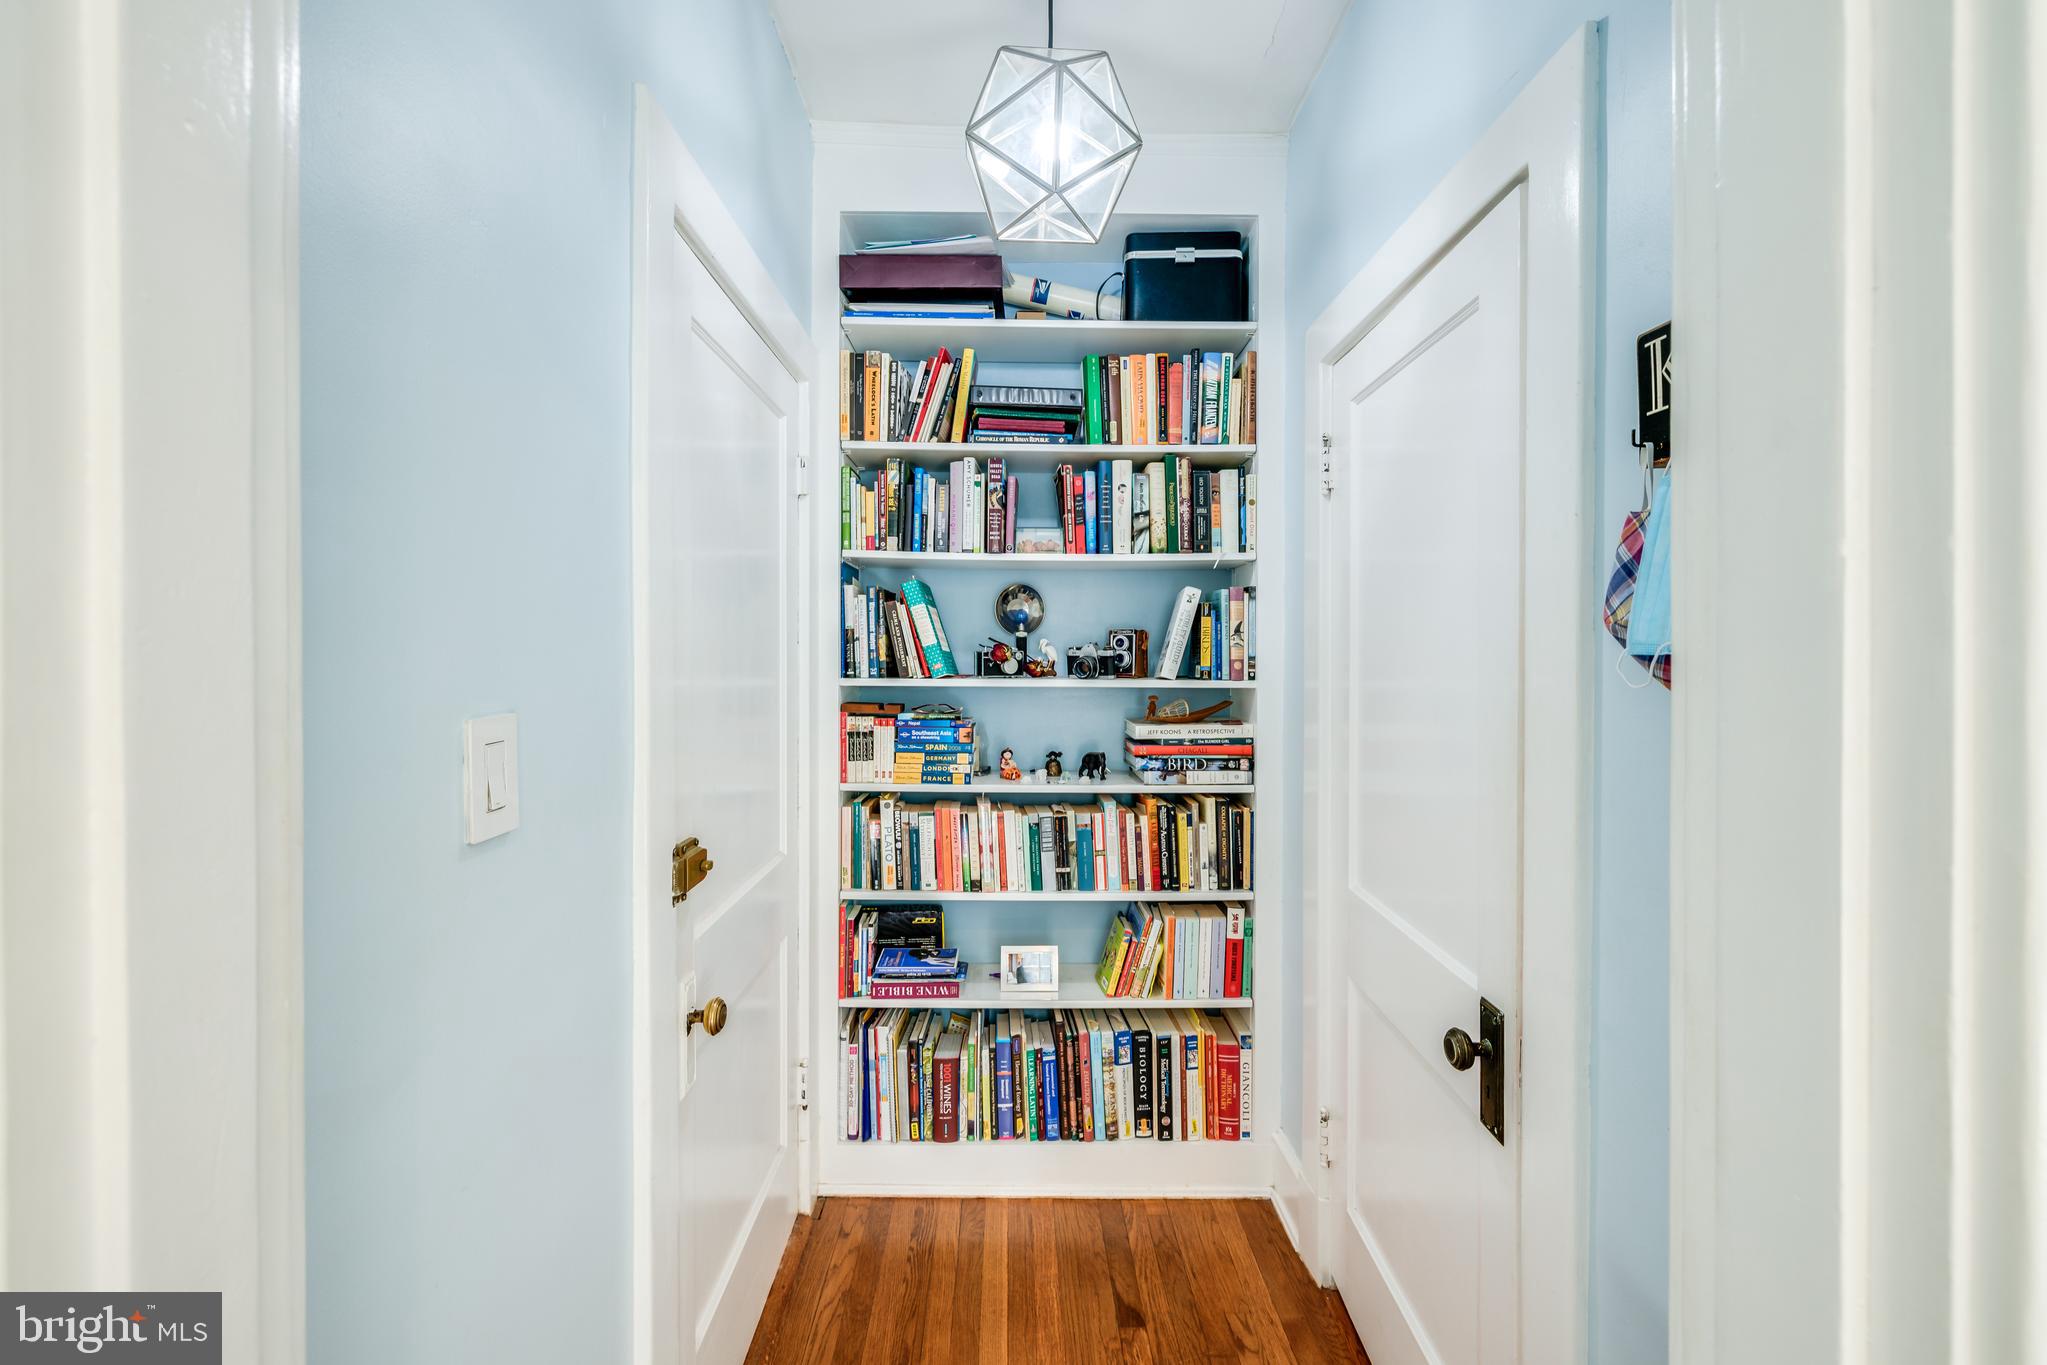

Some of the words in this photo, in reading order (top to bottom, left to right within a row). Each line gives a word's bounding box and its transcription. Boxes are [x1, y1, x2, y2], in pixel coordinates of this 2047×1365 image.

[870, 370, 878, 408] WHEELOCK'S
[897, 638, 907, 668] PUNISHMENT
[1168, 758, 1207, 771] BIRD
[894, 811, 902, 841] BEOWULF
[884, 826, 893, 862] PLATO
[878, 987, 913, 996] BIBLE
[916, 986, 948, 996] WINE
[944, 1063, 952, 1083] 1001
[1028, 1058, 1036, 1095] LEARNING
[1160, 1058, 1168, 1080] Medical
[944, 1084, 952, 1115] WINES
[1160, 1080, 1168, 1113] Terminology
[1220, 1068, 1228, 1110] DICTIONARY
[1242, 1062, 1250, 1121] GIANCOLI
